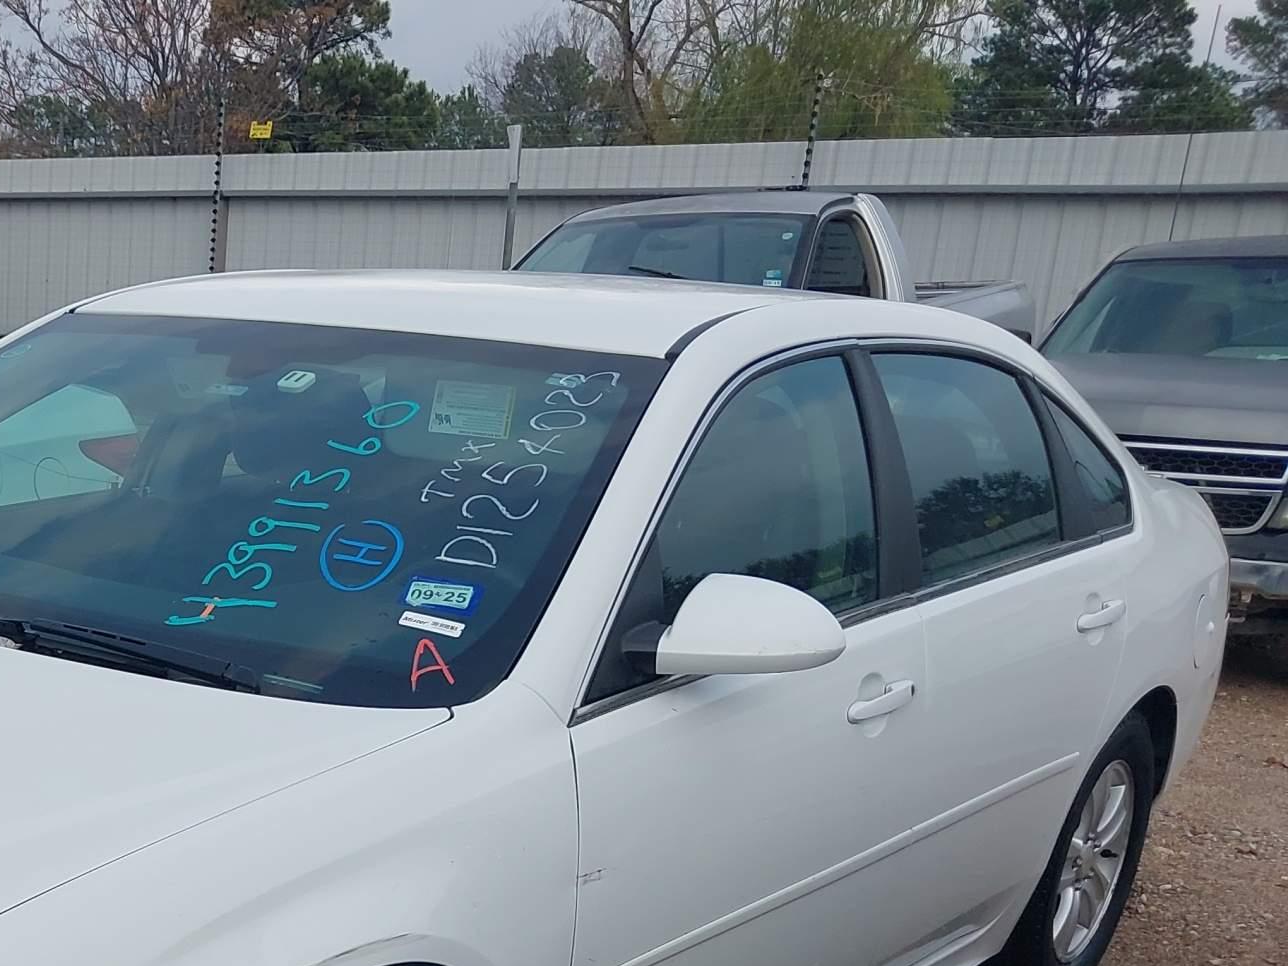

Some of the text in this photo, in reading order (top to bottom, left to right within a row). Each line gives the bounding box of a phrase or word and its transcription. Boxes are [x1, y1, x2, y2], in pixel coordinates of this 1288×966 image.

[164, 401, 420, 626] 43991360
[410, 588, 467, 604] 09 25
[411, 638, 455, 693] A
